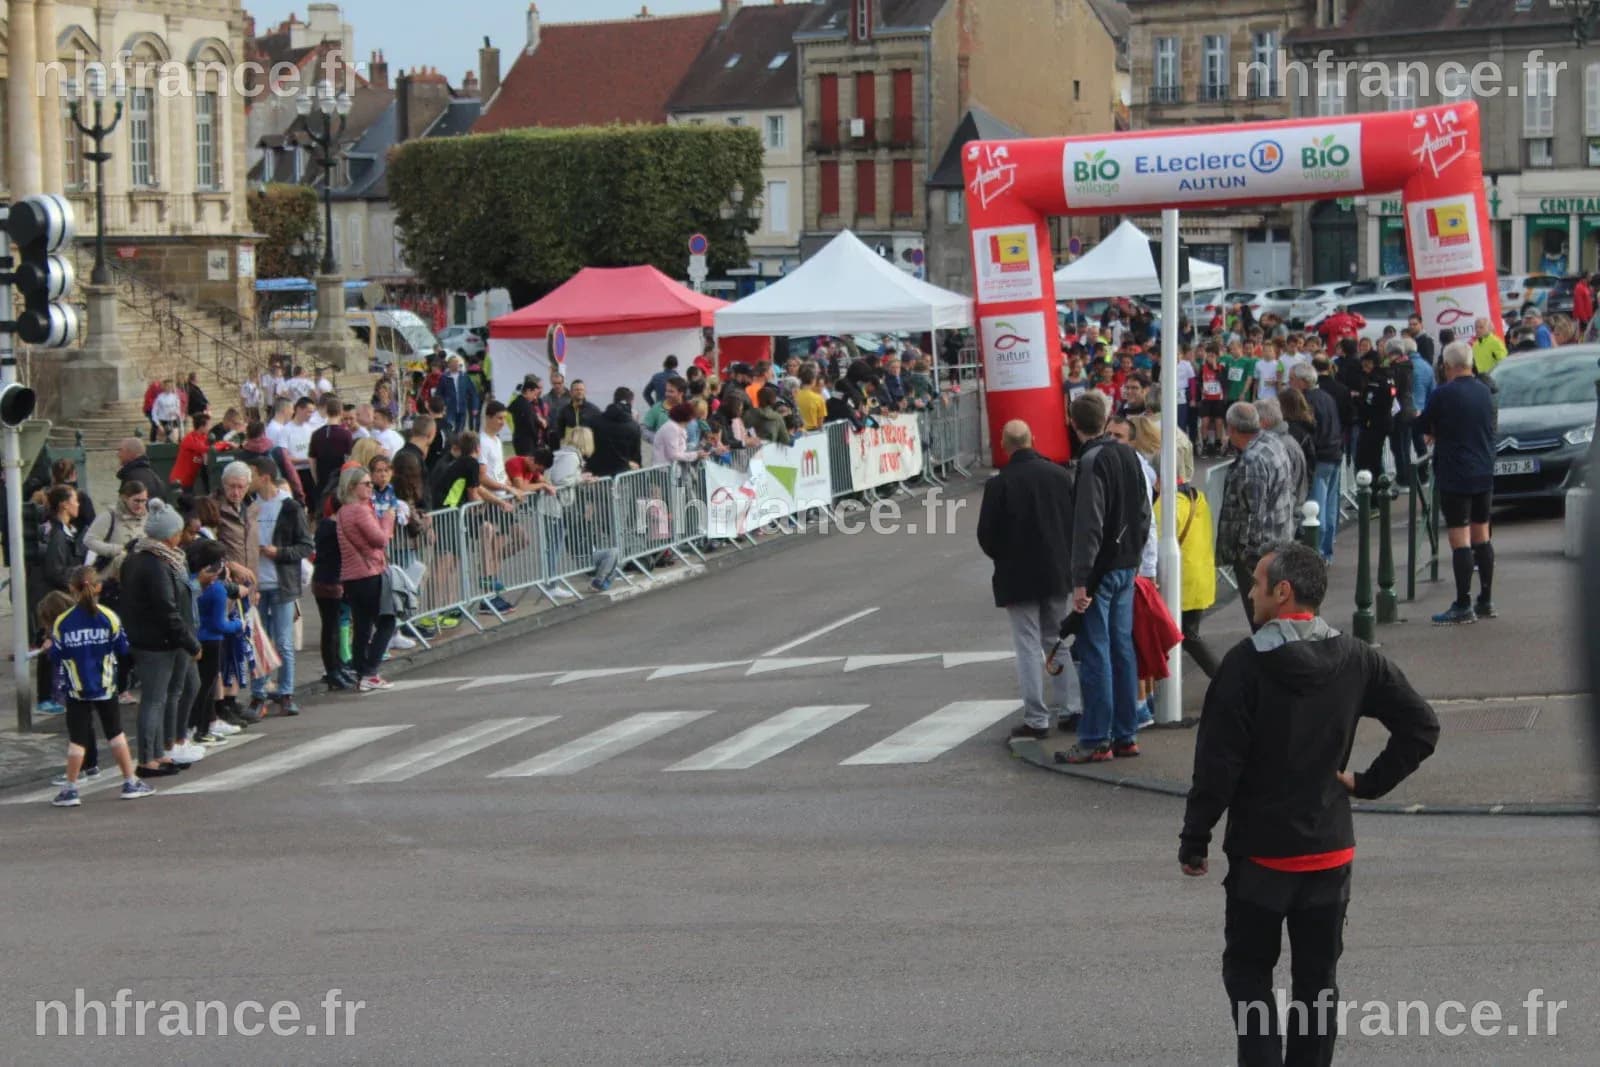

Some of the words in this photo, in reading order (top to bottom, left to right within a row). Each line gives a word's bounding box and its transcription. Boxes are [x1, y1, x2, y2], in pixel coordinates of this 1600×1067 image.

[1135, 152, 1246, 174] E.Leclerc
[1302, 166, 1350, 183] village
[1074, 178, 1120, 197] village
[1179, 175, 1247, 192] AUTUN
[995, 349, 1031, 363] autun
[64, 628, 110, 644] AUTUN
